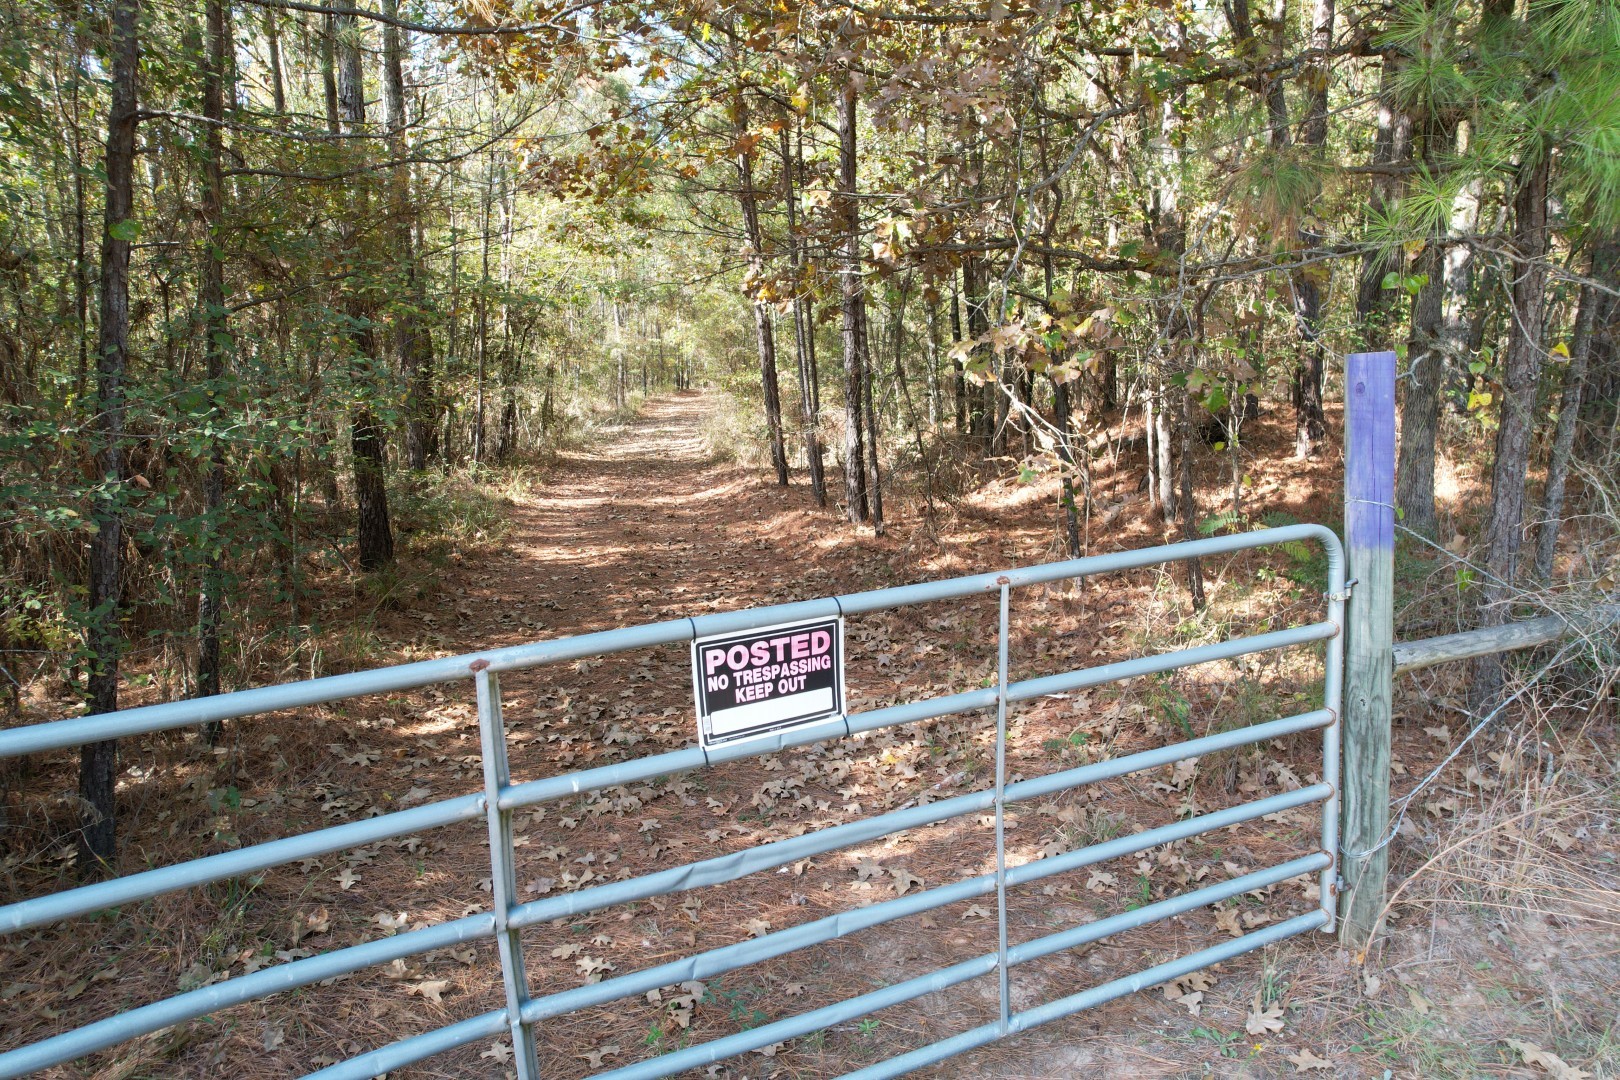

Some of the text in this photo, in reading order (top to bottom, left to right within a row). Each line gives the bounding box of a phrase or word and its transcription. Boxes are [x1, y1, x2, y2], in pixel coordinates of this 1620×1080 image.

[705, 631, 831, 675] POSTED
[707, 655, 831, 692] NO TRESPASSING
[735, 675, 807, 704] KEEP OUT
